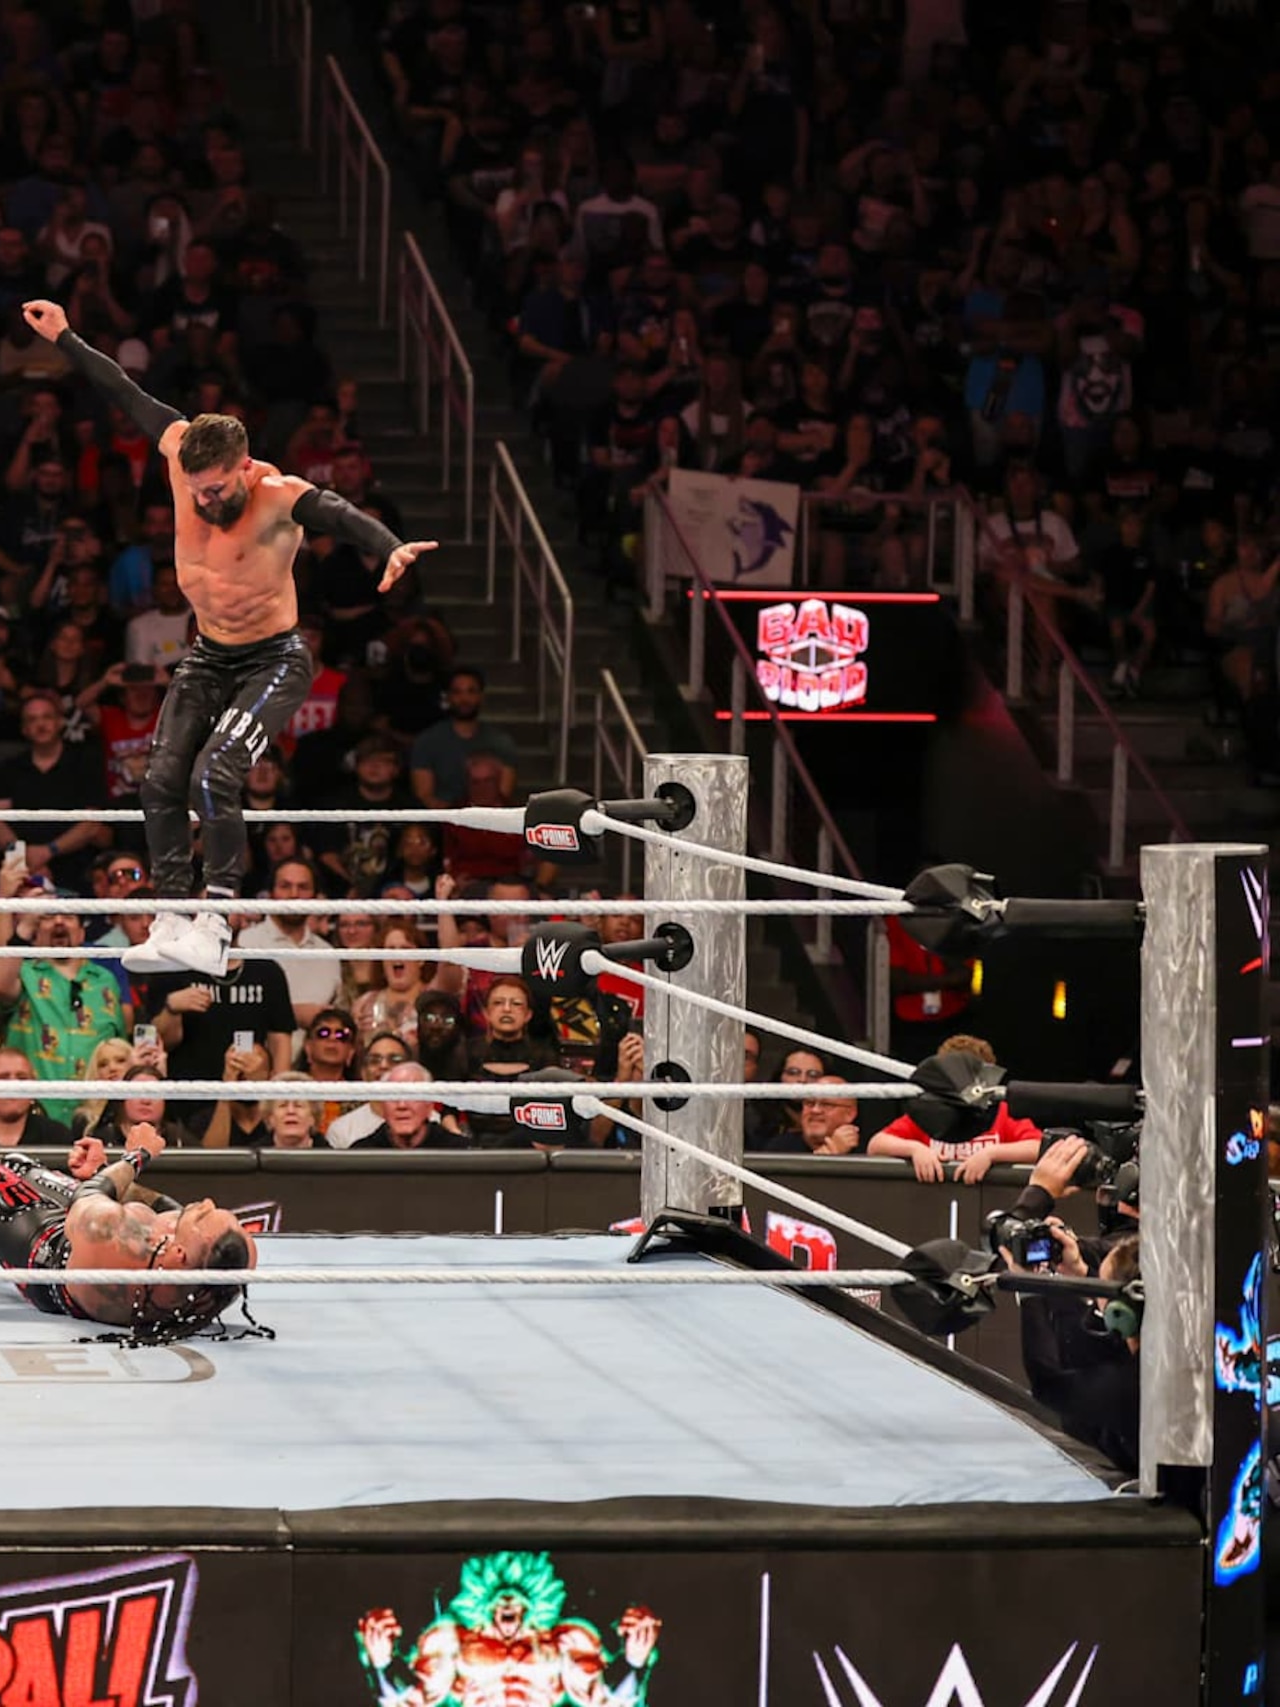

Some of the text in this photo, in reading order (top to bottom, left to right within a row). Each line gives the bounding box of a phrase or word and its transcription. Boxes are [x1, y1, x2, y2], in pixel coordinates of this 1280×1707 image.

[757, 599, 869, 652] BAD
[755, 659, 868, 712] BLOOD
[541, 828, 576, 846] PRIME
[529, 1106, 564, 1126] PRIME
